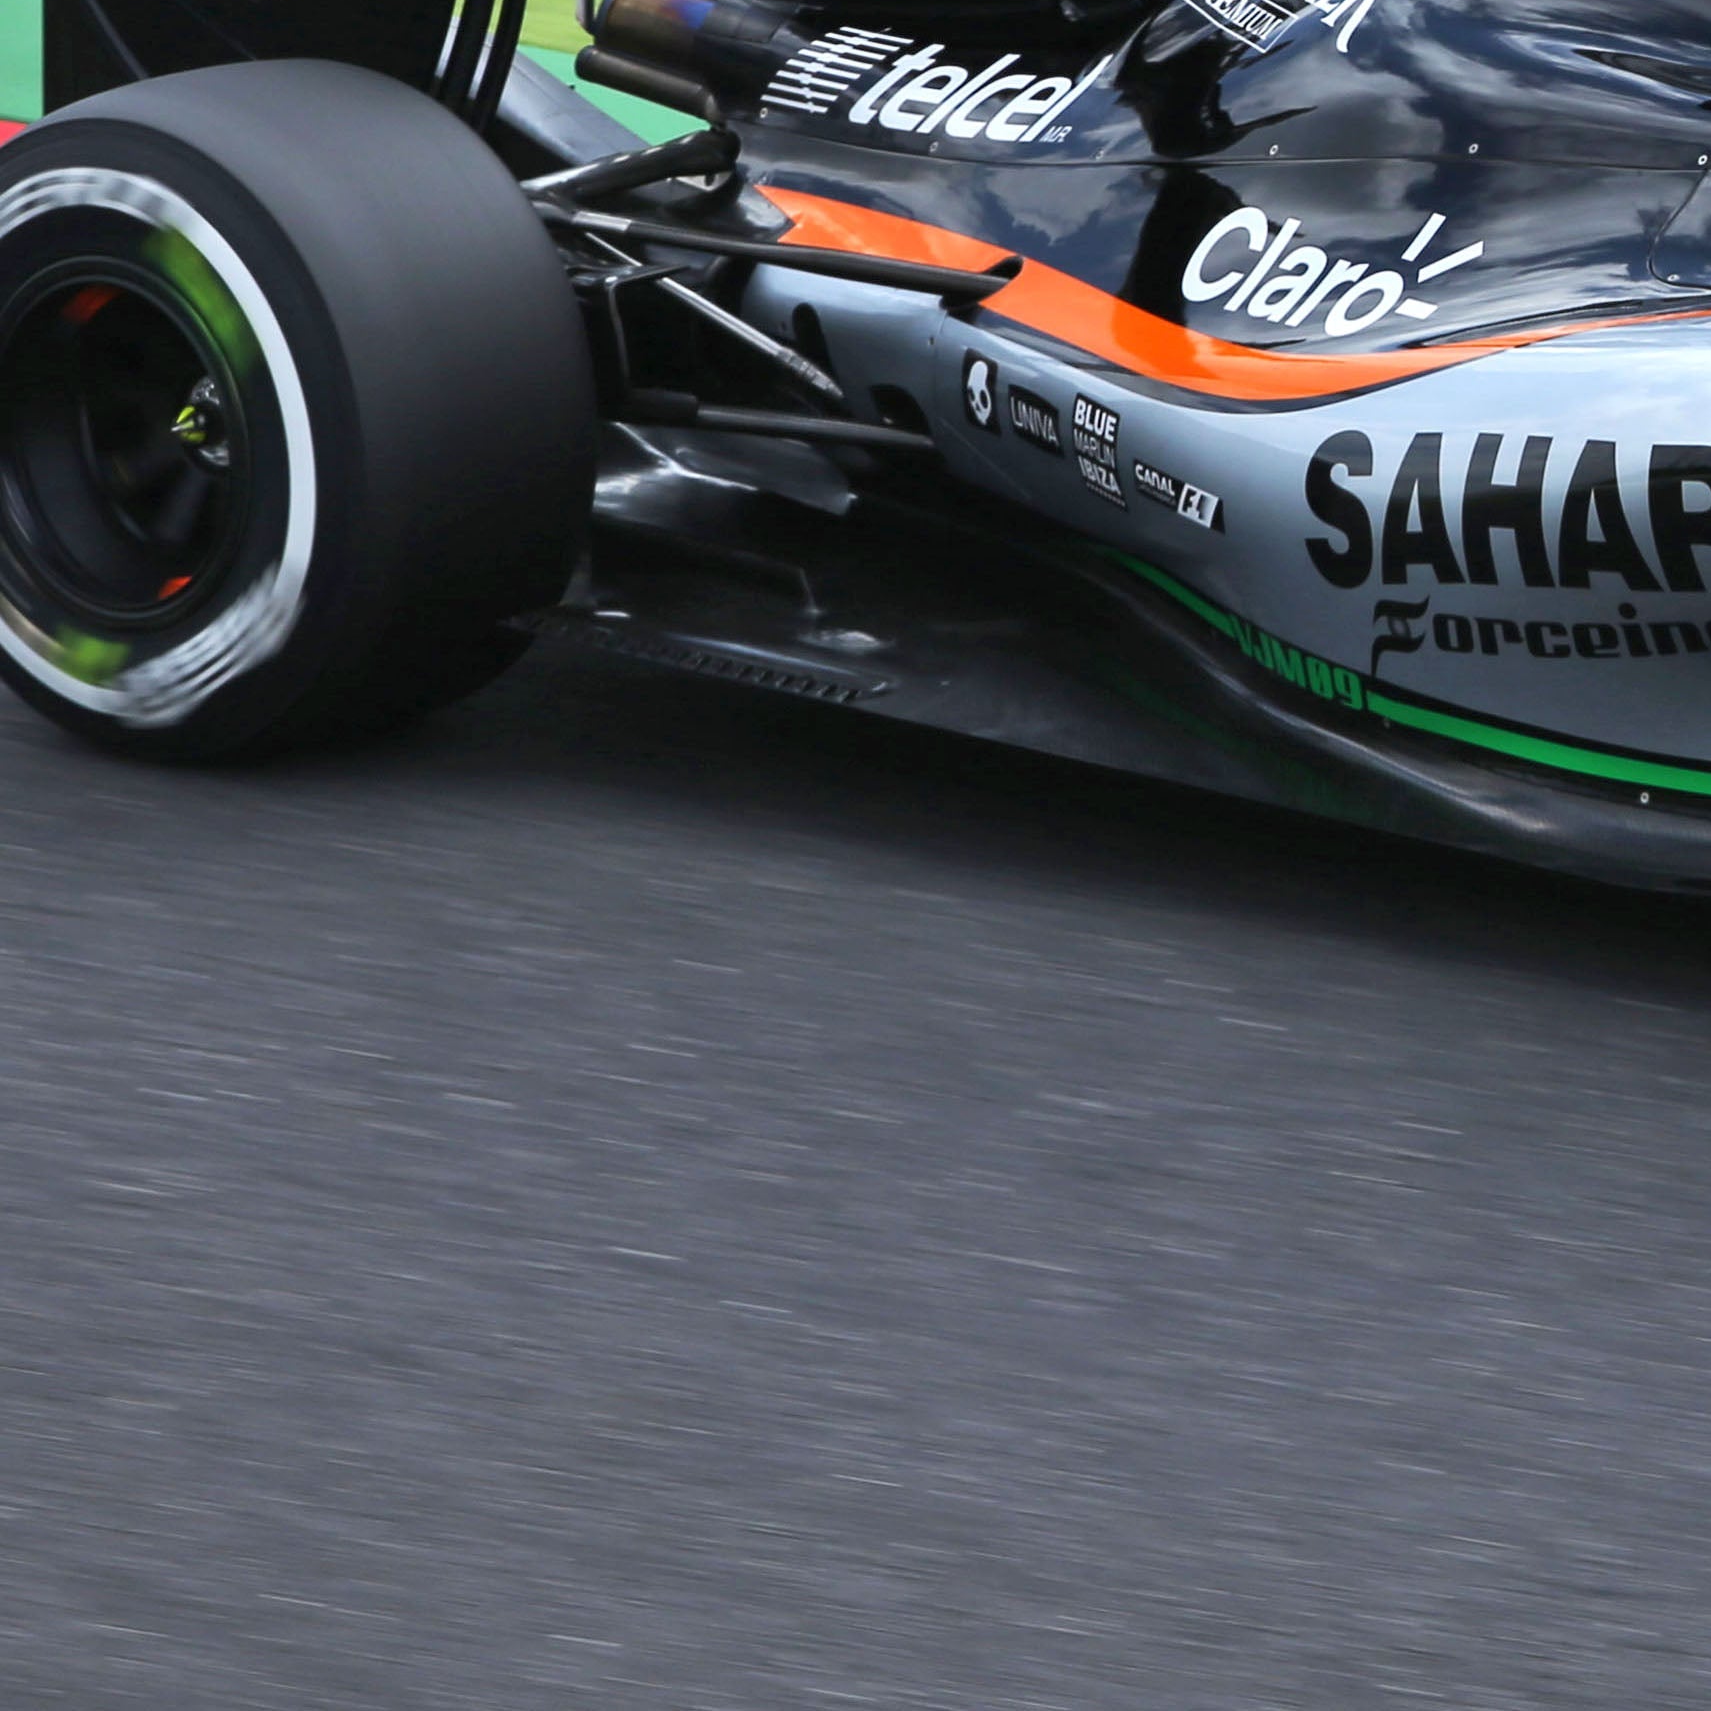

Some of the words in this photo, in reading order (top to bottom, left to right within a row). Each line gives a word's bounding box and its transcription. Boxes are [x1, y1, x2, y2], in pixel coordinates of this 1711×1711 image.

[849, 44, 1113, 142] telcel
[1181, 206, 1403, 336] Claro
[1074, 399, 1117, 442] BLUE
[1078, 455, 1121, 496] IBIZA
[1135, 463, 1175, 496] CANAL
[1230, 614, 1363, 710] VJM09
